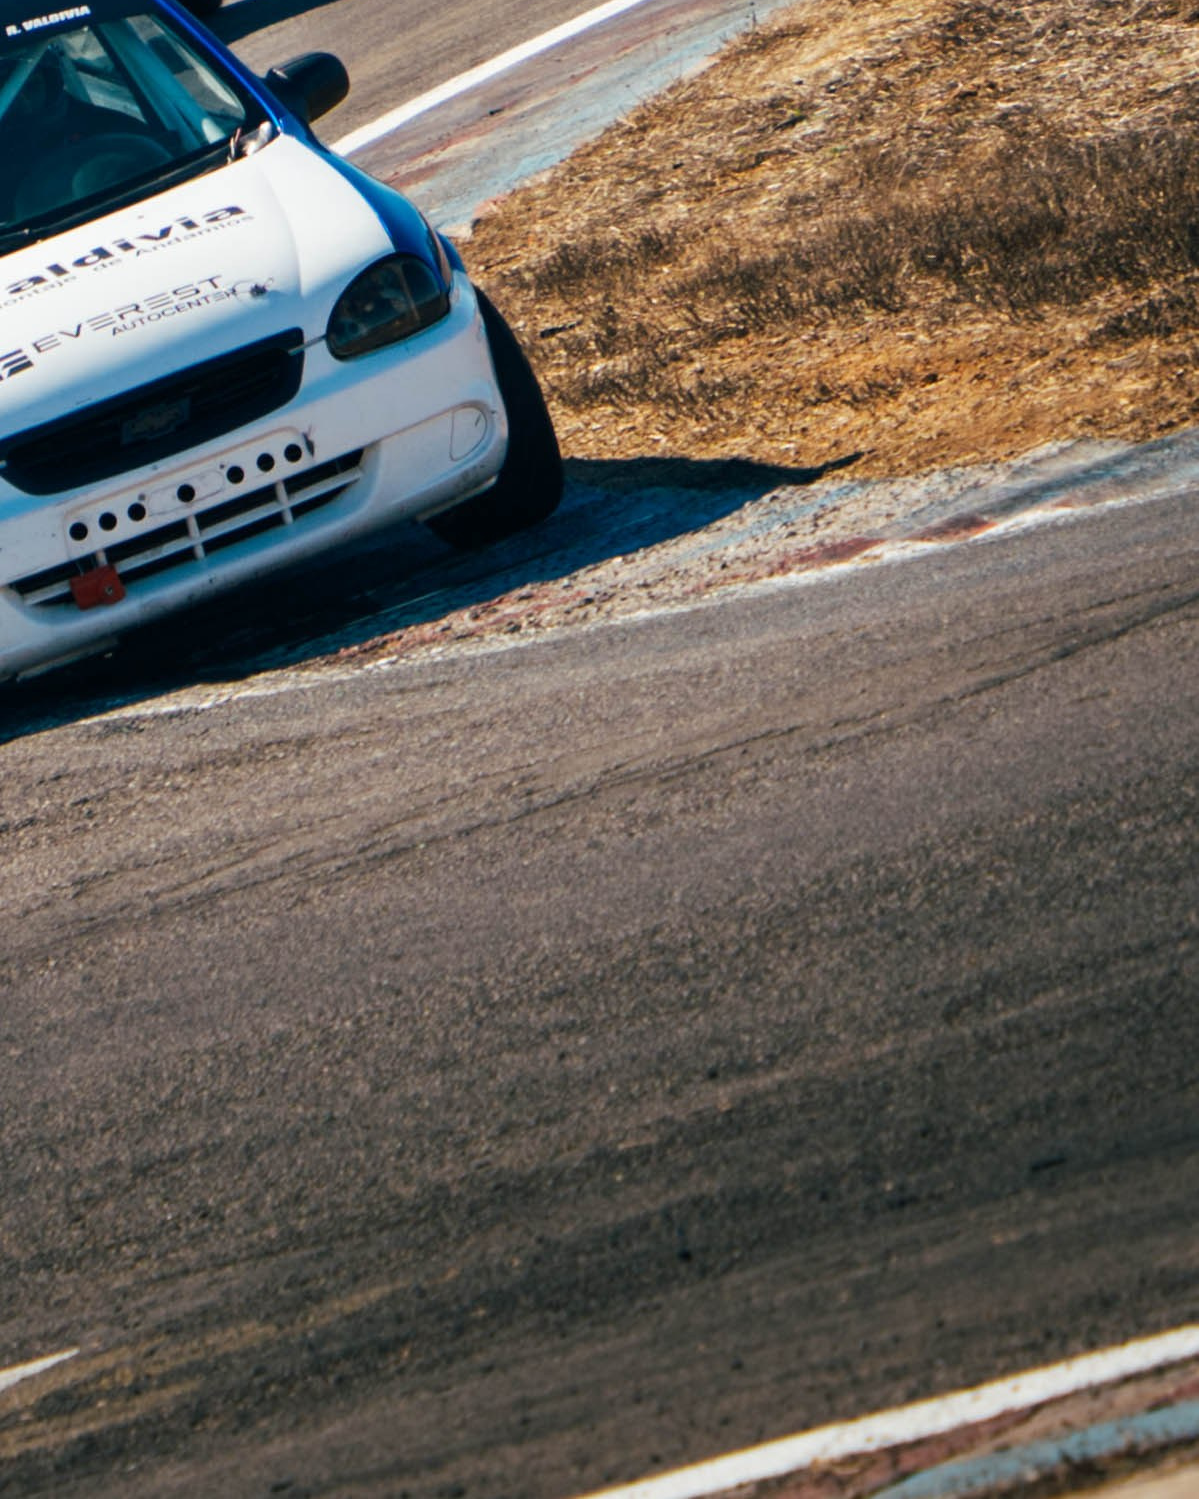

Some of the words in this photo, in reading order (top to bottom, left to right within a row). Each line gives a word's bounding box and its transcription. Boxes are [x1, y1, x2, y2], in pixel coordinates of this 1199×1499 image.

[22, 4, 91, 32] VALDIVIA
[92, 257, 123, 274] de
[135, 214, 256, 258] Andamios
[32, 274, 223, 354] EVEREST
[111, 288, 241, 337] AUTOCENTER
